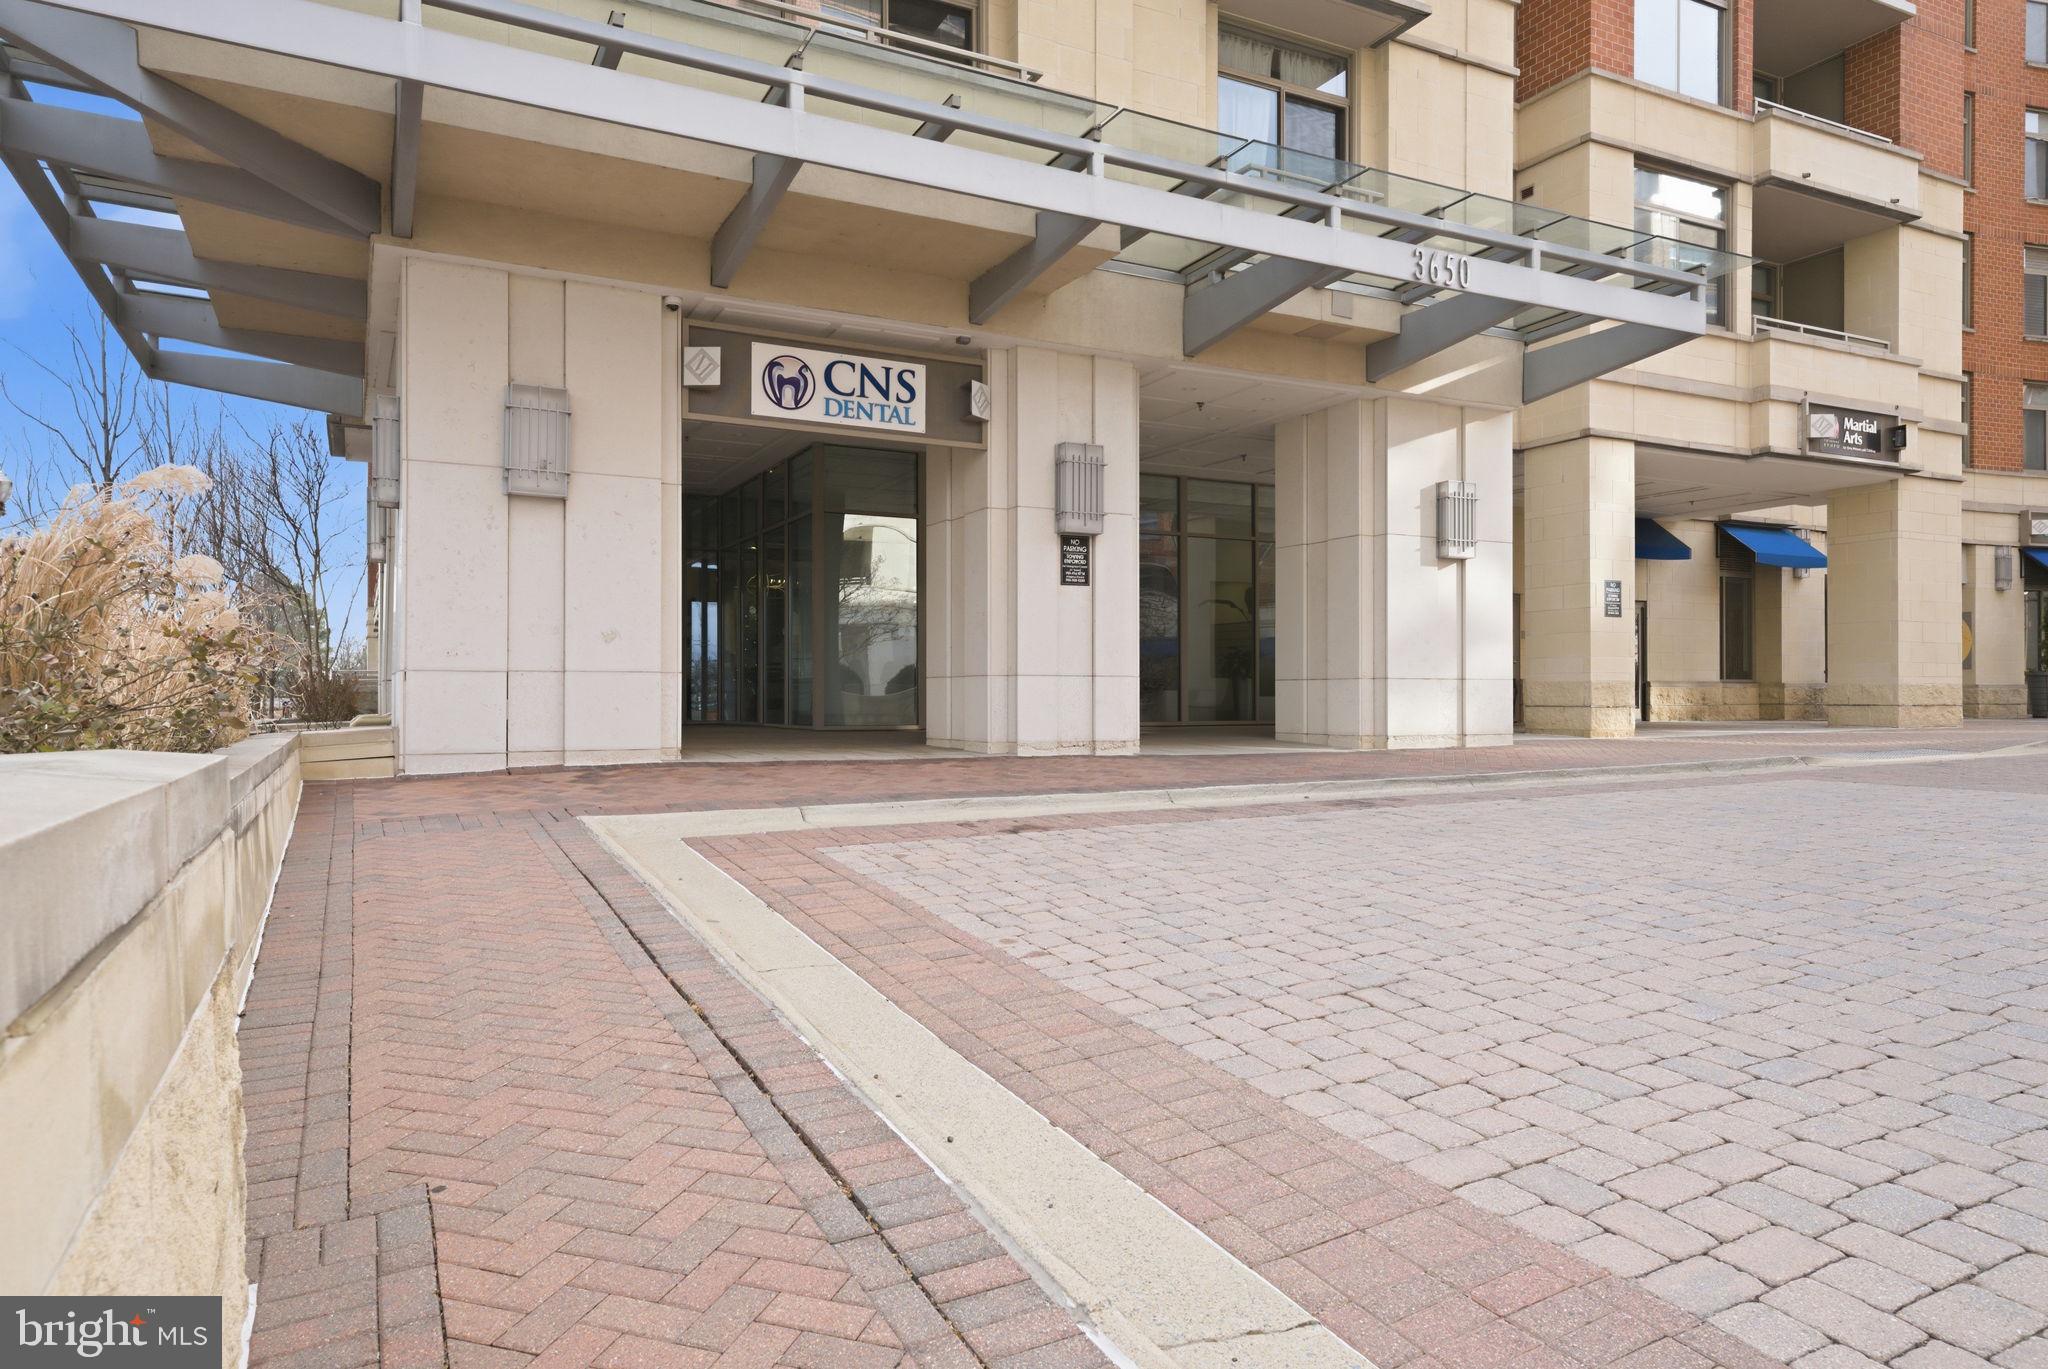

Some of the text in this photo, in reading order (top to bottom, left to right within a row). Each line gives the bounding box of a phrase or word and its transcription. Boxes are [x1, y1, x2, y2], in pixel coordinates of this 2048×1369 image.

[1413, 247, 1469, 289] 3650
[823, 360, 917, 404] CNS
[823, 396, 917, 426] DENTAL
[1843, 417, 1877, 434] Martial
[1843, 430, 1863, 445] Arts
[1063, 545, 1087, 553] PARKING
